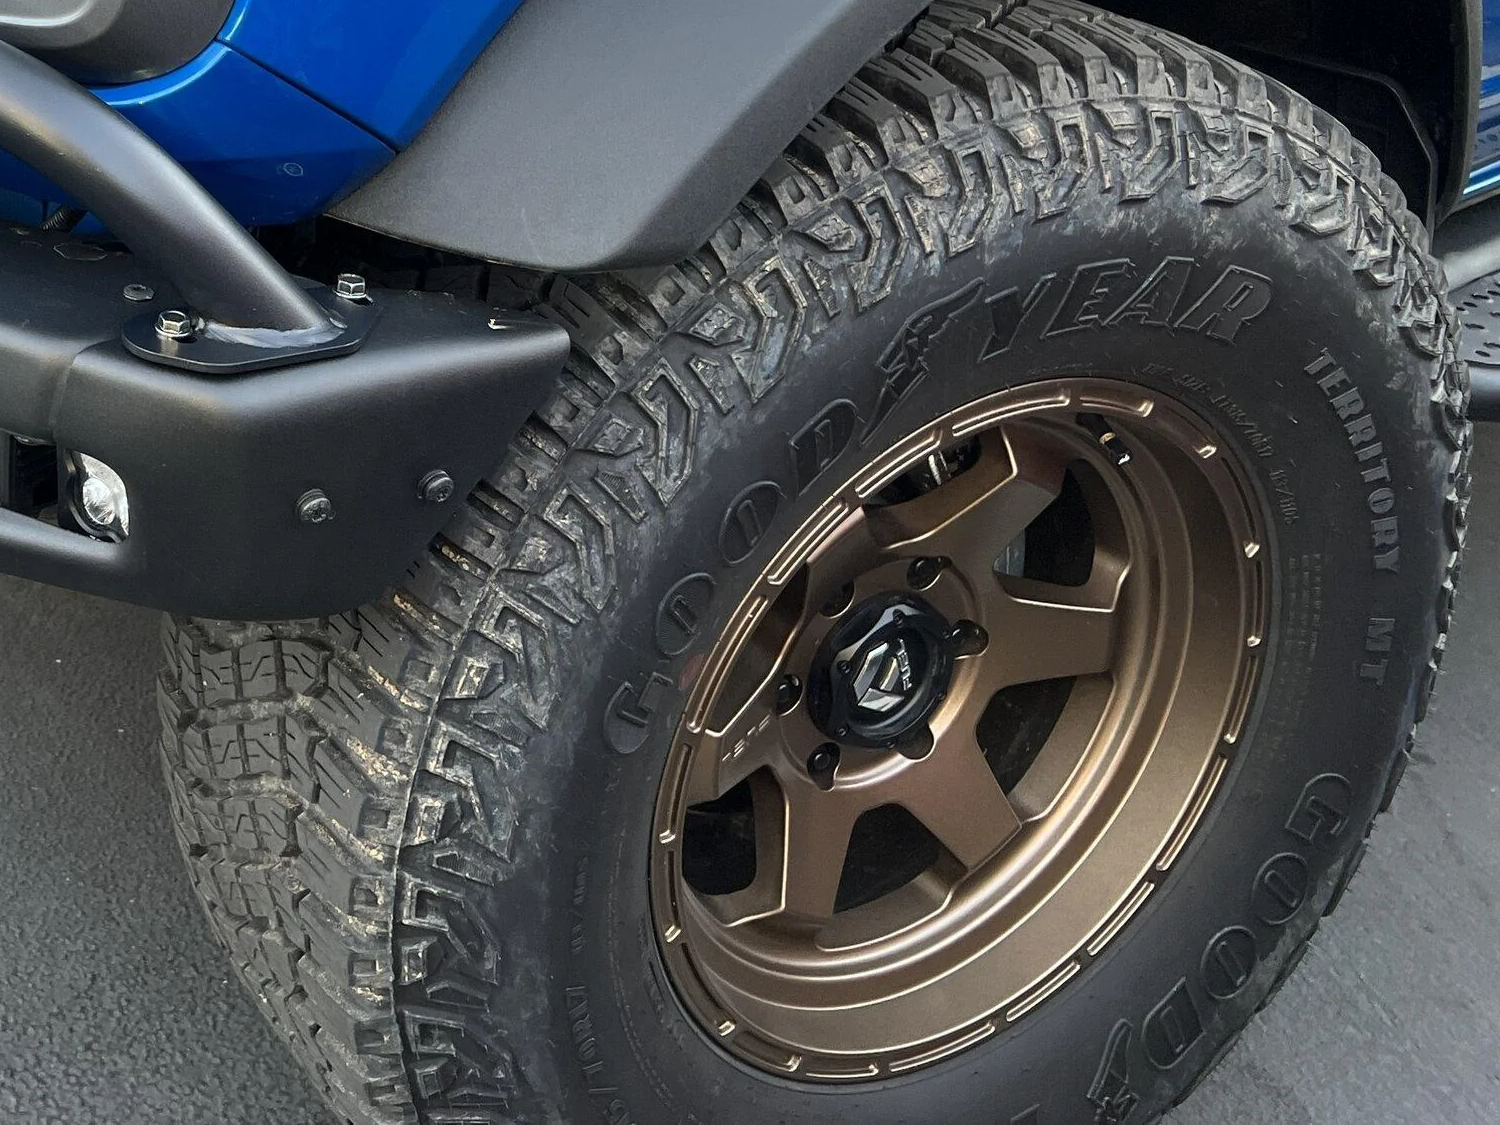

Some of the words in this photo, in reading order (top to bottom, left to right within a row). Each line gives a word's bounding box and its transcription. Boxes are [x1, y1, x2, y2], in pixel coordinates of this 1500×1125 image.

[1303, 345, 1401, 575] TERRITORY
[1359, 616, 1396, 688] MT
[896, 638, 913, 691] FUEL
